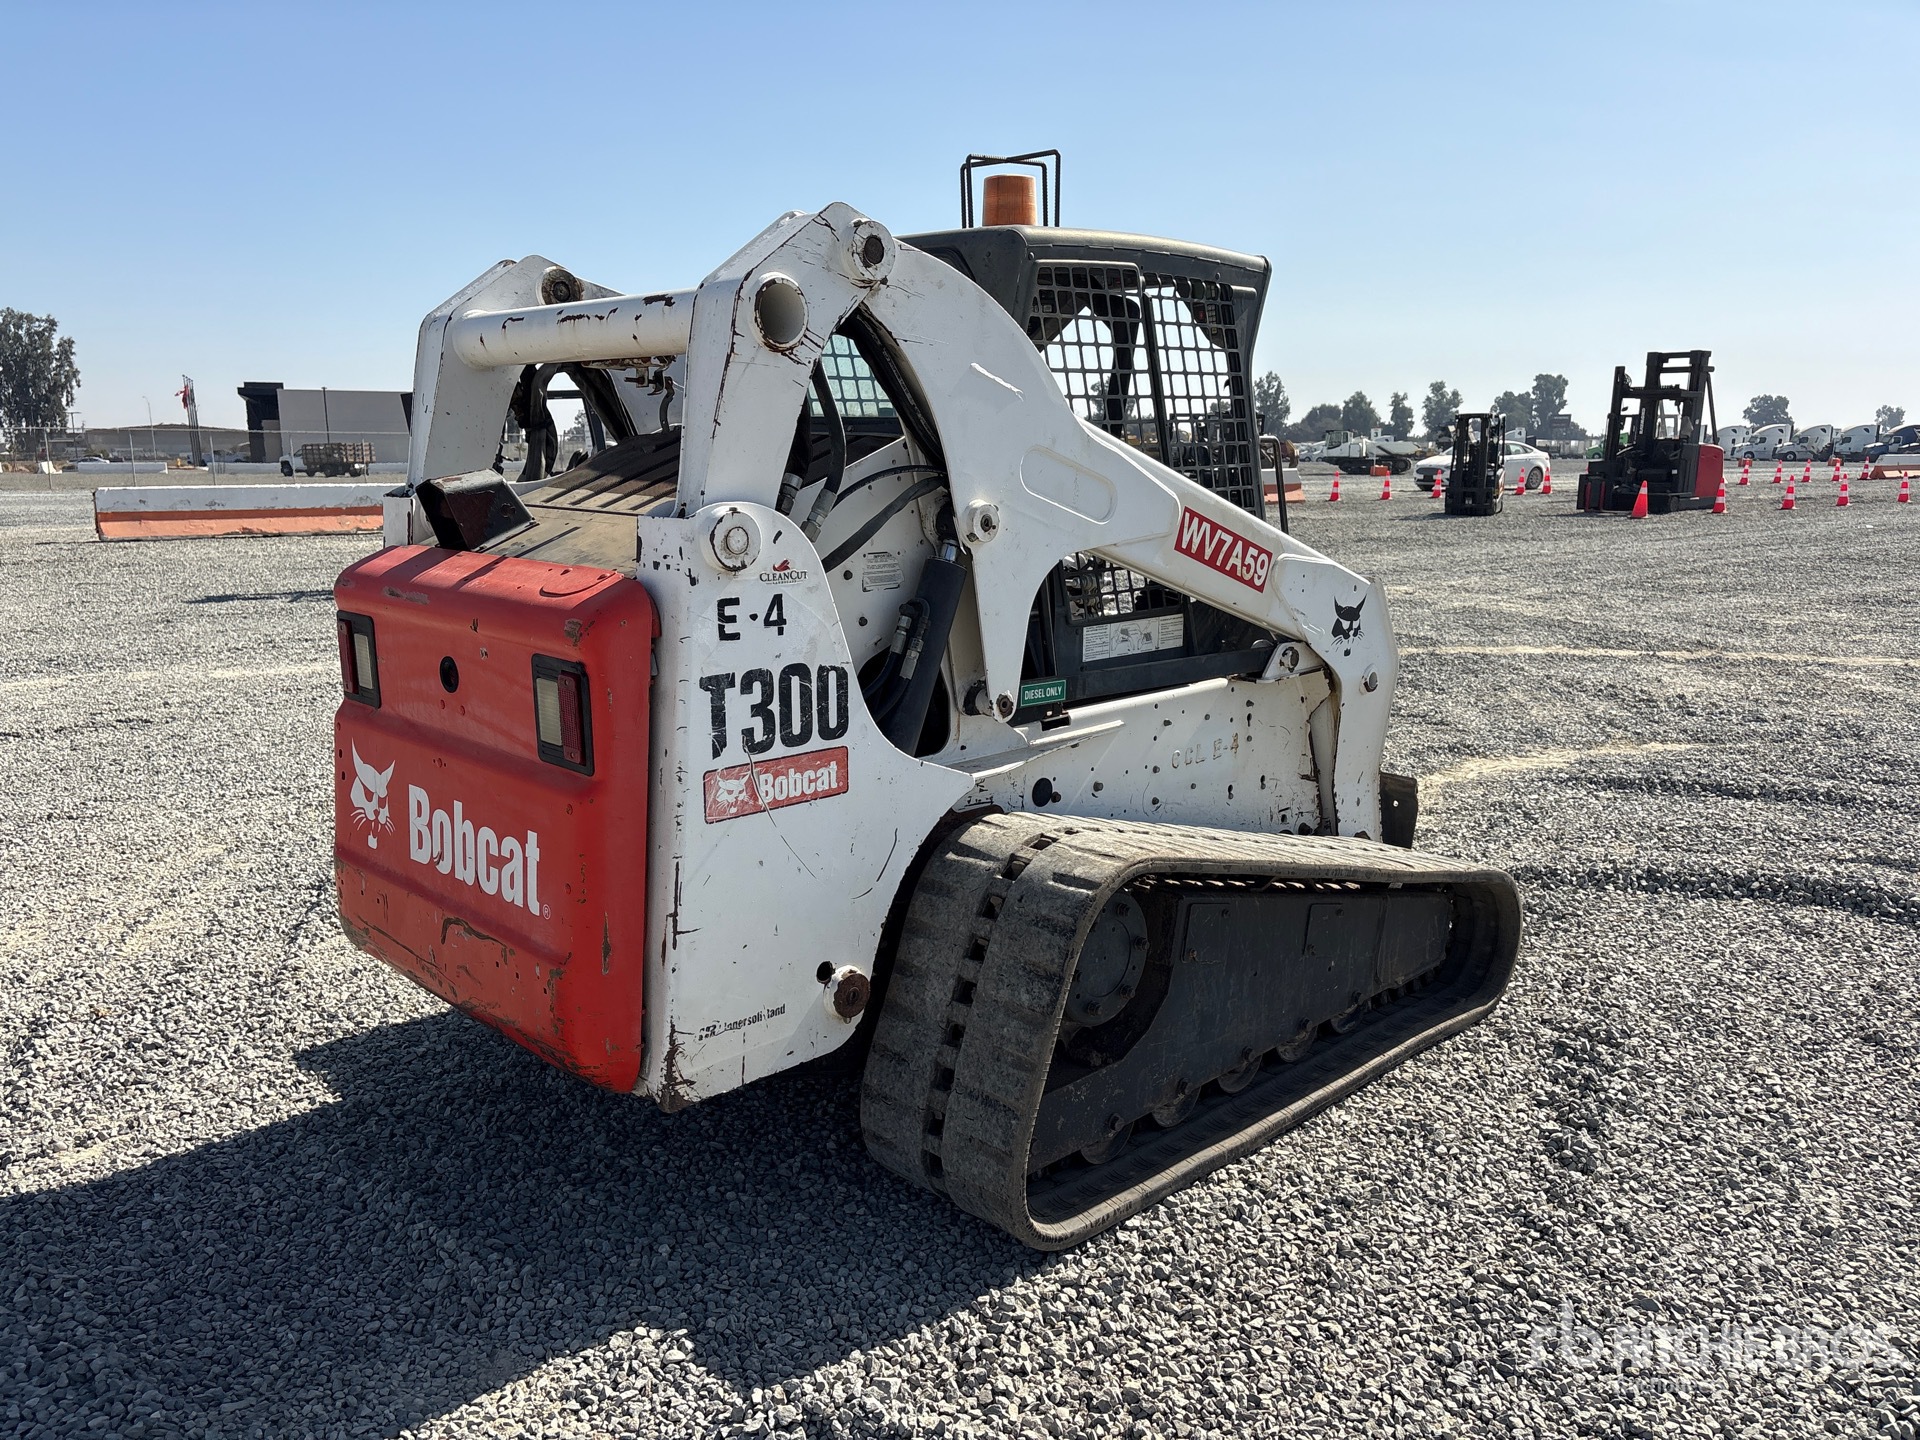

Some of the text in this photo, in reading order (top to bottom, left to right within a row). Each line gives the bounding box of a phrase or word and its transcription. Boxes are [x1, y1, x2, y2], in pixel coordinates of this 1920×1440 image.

[1180, 511, 1269, 587] WV7A59
[699, 662, 849, 760] T300
[1024, 685, 1063, 700] DIESEL ONLY
[757, 761, 839, 804] Bobcat
[408, 784, 540, 916] Bobcat
